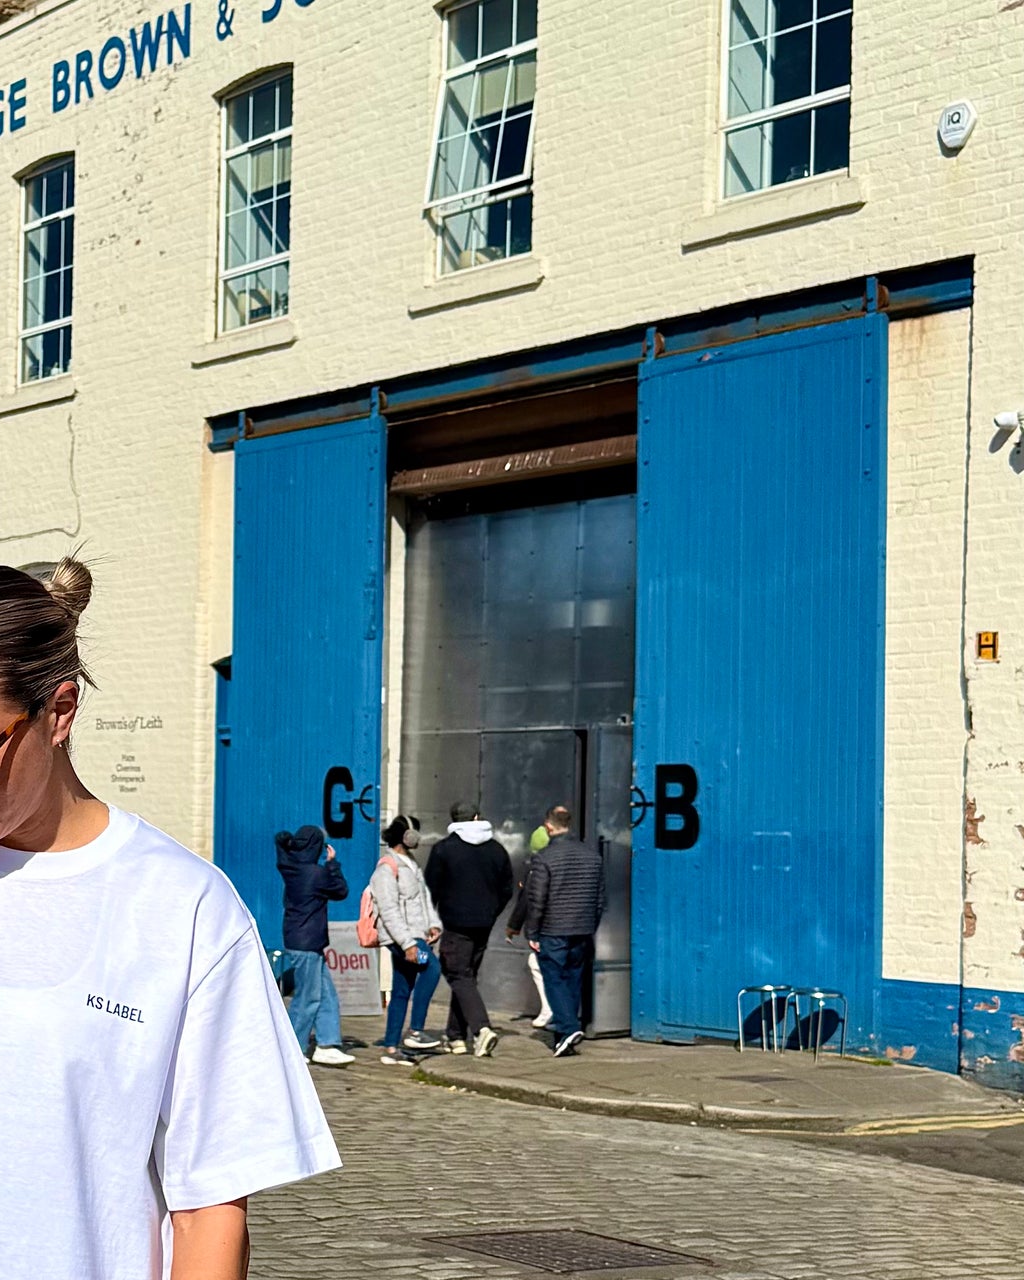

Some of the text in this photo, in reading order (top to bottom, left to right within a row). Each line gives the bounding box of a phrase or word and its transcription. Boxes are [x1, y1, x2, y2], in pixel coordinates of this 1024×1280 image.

[52, 4, 191, 113] BROWN
[216, 0, 234, 42] &
[978, 632, 997, 659] H
[128, 716, 141, 733] of
[140, 716, 163, 729] Leith
[323, 766, 354, 839] G
[655, 764, 701, 850] B
[325, 948, 370, 974] Open
[86, 993, 145, 1024] KS LABEL
